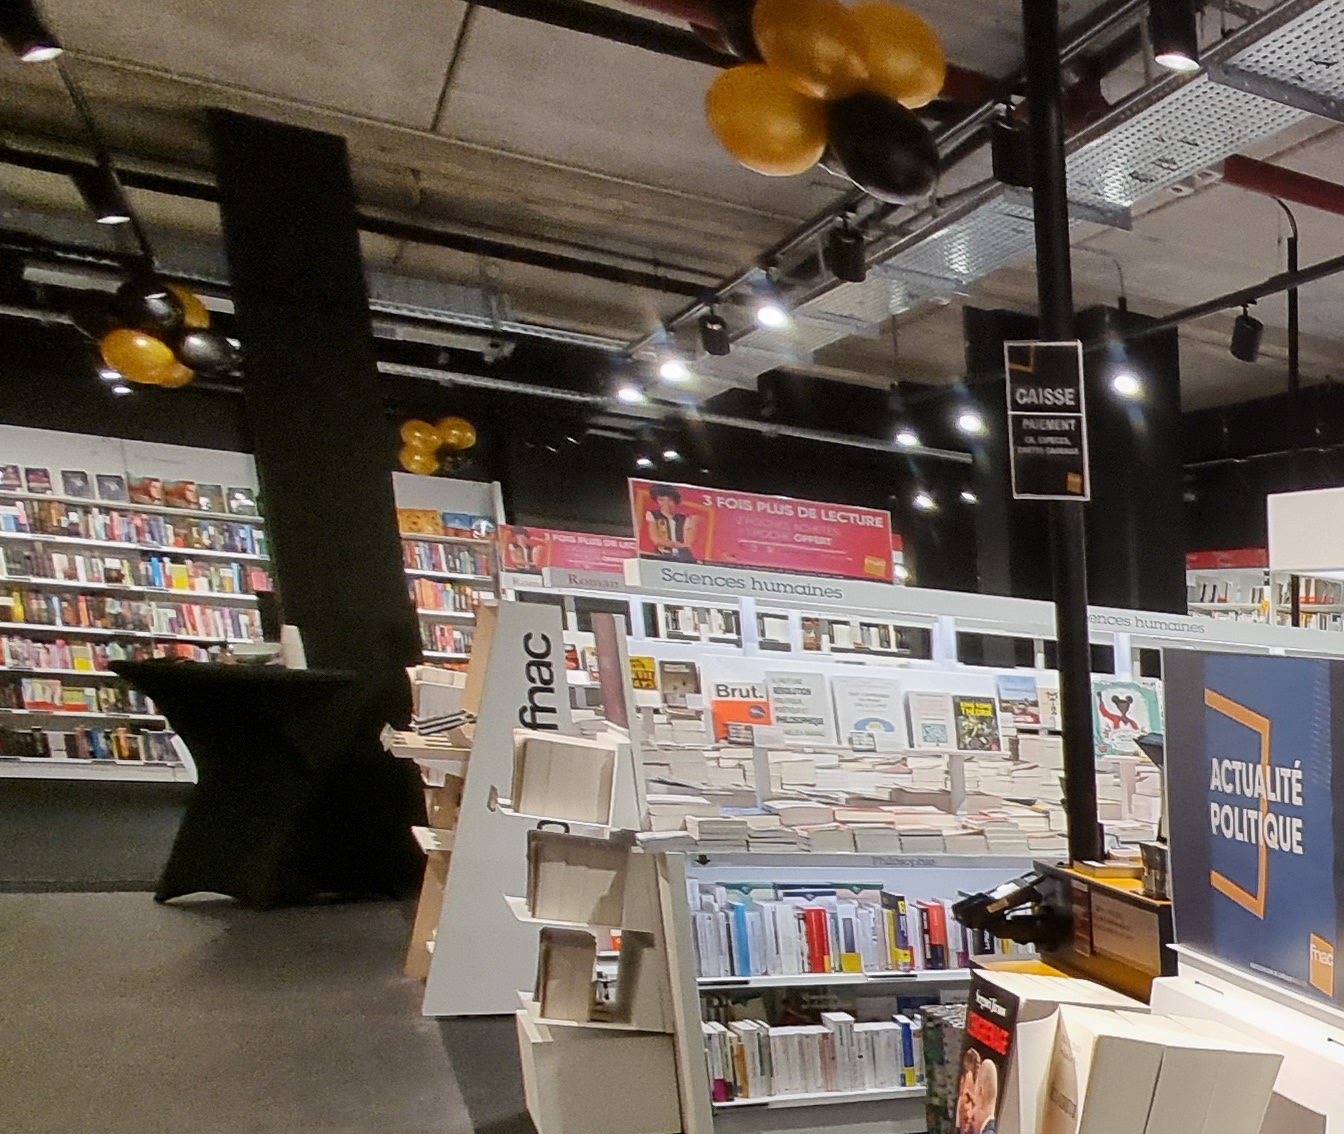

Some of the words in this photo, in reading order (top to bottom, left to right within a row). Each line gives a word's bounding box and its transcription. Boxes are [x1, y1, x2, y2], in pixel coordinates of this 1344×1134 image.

[1015, 388, 1076, 406] CAISSE
[1022, 419, 1076, 431] PAIEMENT
[702, 494, 713, 507] 3
[716, 496, 753, 513] FOIS
[756, 500, 795, 517] PLUS
[798, 505, 819, 520] DE
[821, 508, 884, 529] LECTURE
[660, 567, 746, 589] Sciences
[751, 578, 844, 599] humaines
[1088, 614, 1131, 627] ences
[1134, 616, 1206, 633] humaines
[518, 631, 559, 731] fnac
[715, 682, 765, 701] Brut.
[1210, 757, 1304, 807] ACTUALITÉ
[1210, 802, 1305, 856] POLITIQUE
